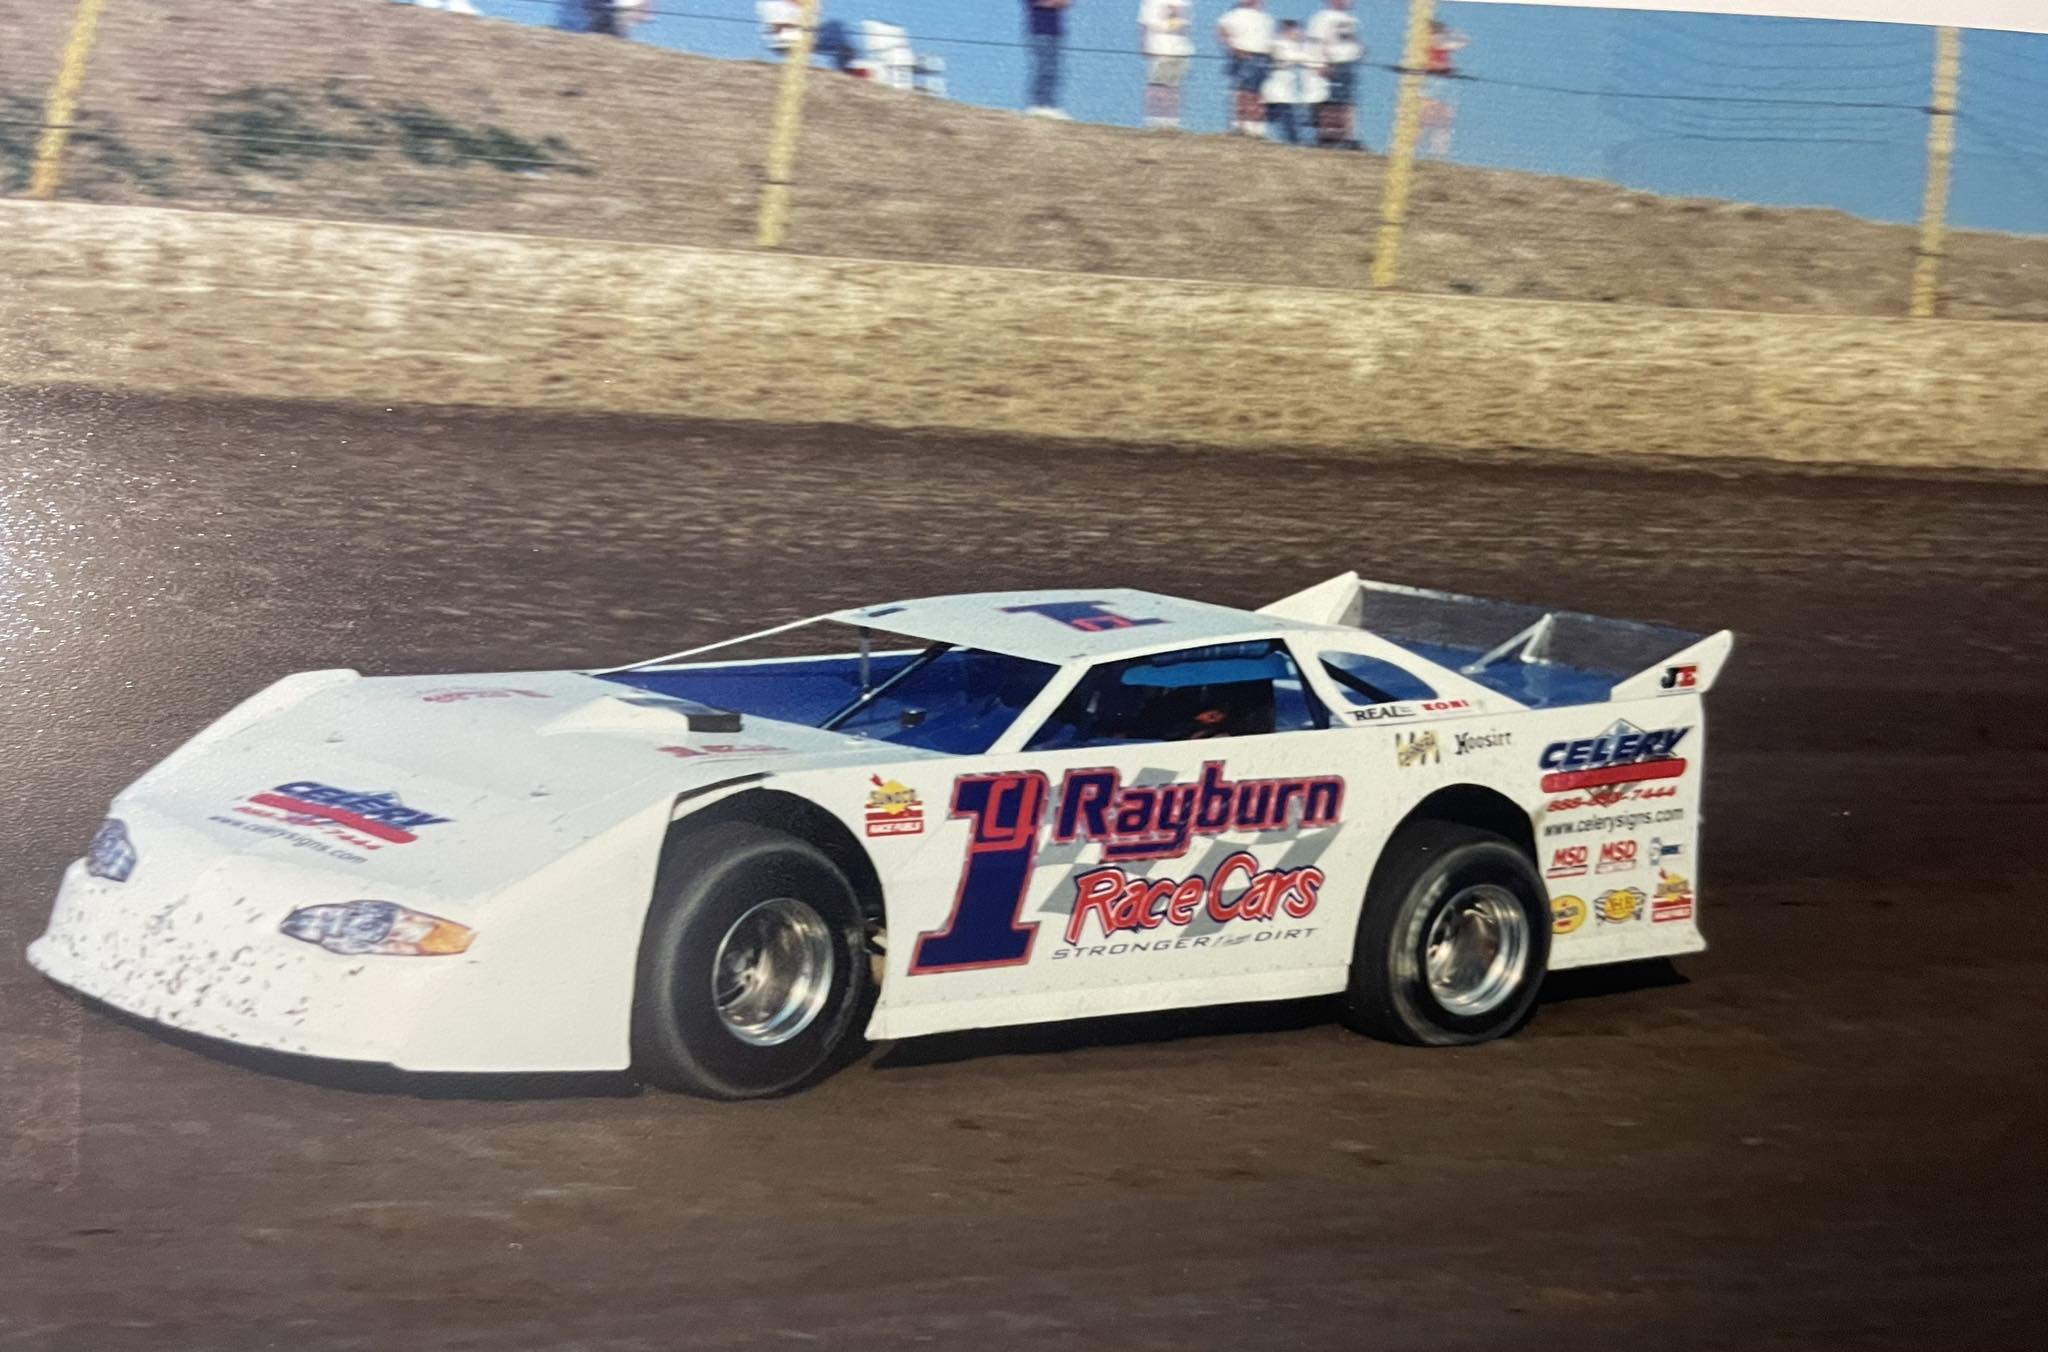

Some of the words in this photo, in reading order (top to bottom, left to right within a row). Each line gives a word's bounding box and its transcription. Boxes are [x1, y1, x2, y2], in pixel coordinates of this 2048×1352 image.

[1346, 705, 1415, 721] REAL
[1539, 726, 1694, 770] CELERY
[1051, 759, 1345, 862] Rayburn
[1543, 807, 1684, 837] www.celerysigns.com
[1551, 846, 1588, 867] MSD
[1600, 840, 1637, 862] MSD
[1063, 864, 1207, 946] Race
[1208, 851, 1326, 927] Cars
[1051, 937, 1211, 960] STRONGER
[1255, 928, 1318, 945] DIRT
